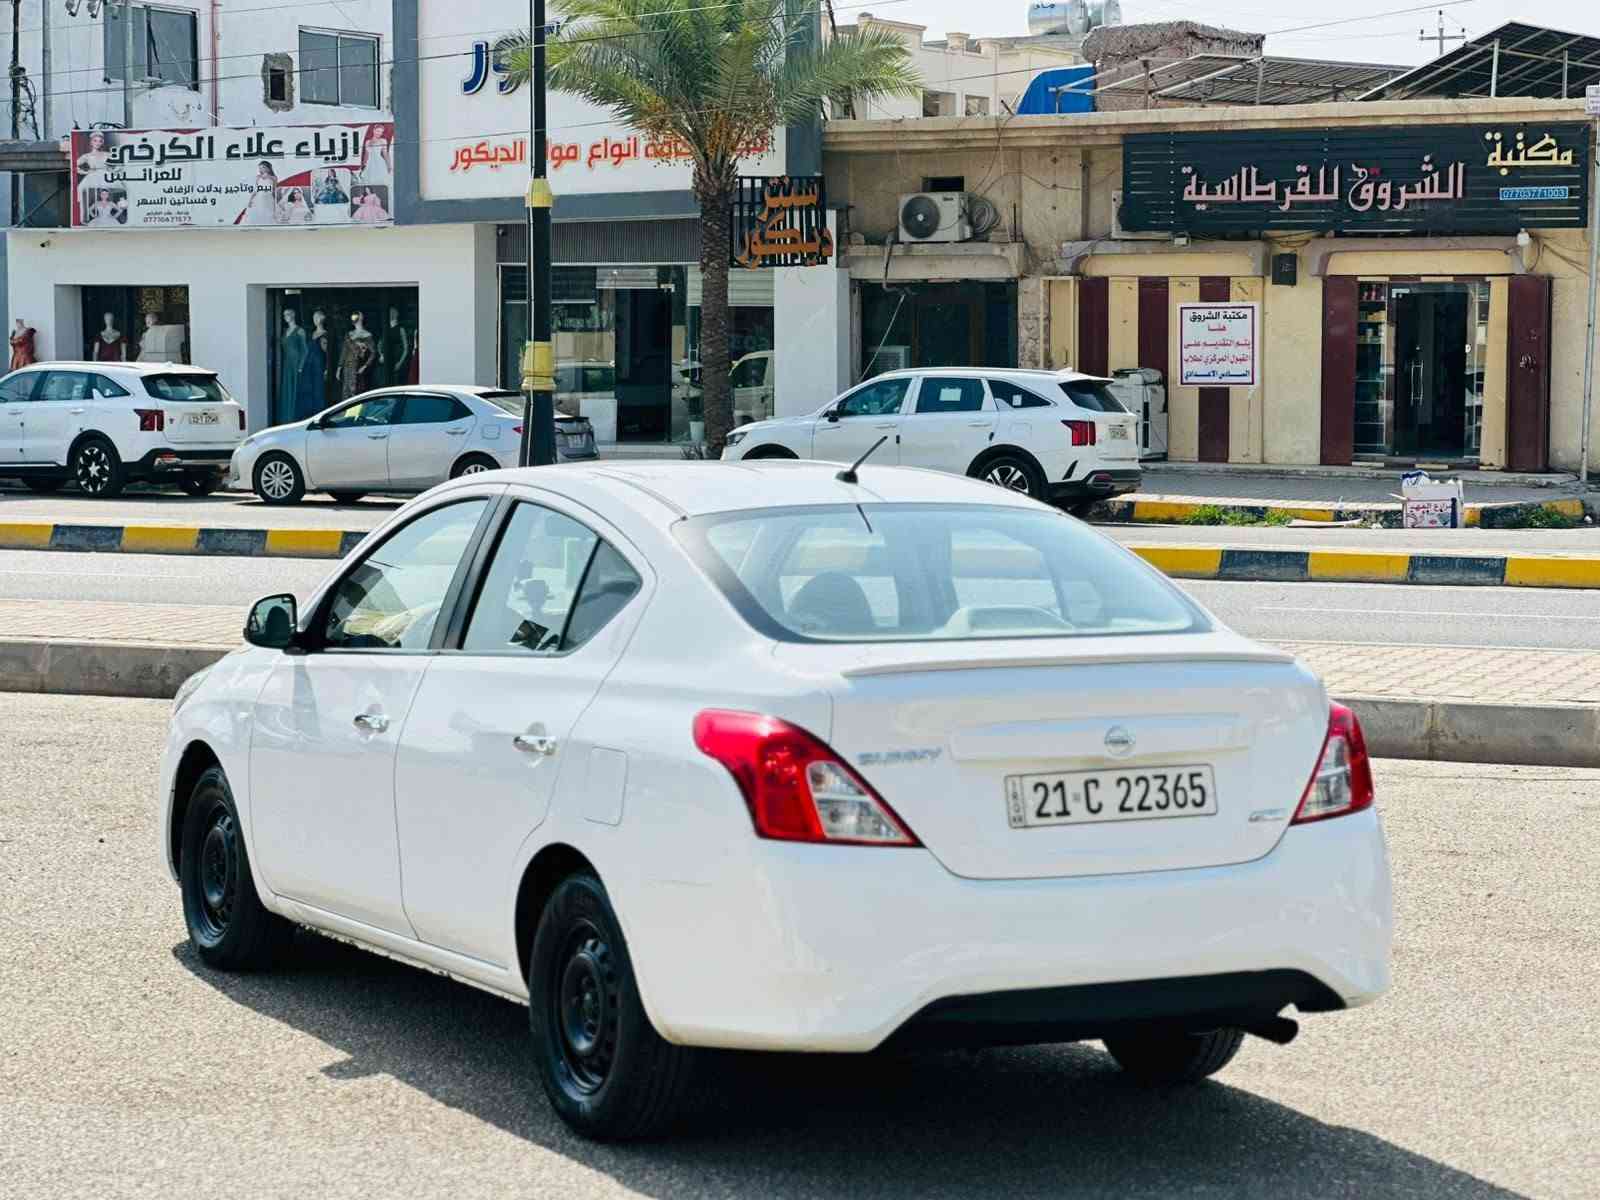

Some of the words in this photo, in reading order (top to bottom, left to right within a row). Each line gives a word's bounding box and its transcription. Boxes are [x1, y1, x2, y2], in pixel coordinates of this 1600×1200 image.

[105, 136, 214, 165] الكرخي
[226, 131, 284, 158] علاء
[296, 131, 359, 161] ازياء
[450, 140, 526, 171] الديكور
[587, 137, 638, 169] انواع
[1485, 131, 1573, 175] مكتبة
[1181, 163, 1340, 211] للقرطاسية
[1348, 154, 1465, 212] الشروق
[1190, 311, 1220, 322] الشروق
[1223, 311, 1248, 322] مكتبة
[1033, 780, 1071, 818] 21
[1084, 778, 1103, 815] C
[1115, 772, 1208, 813] 22365
